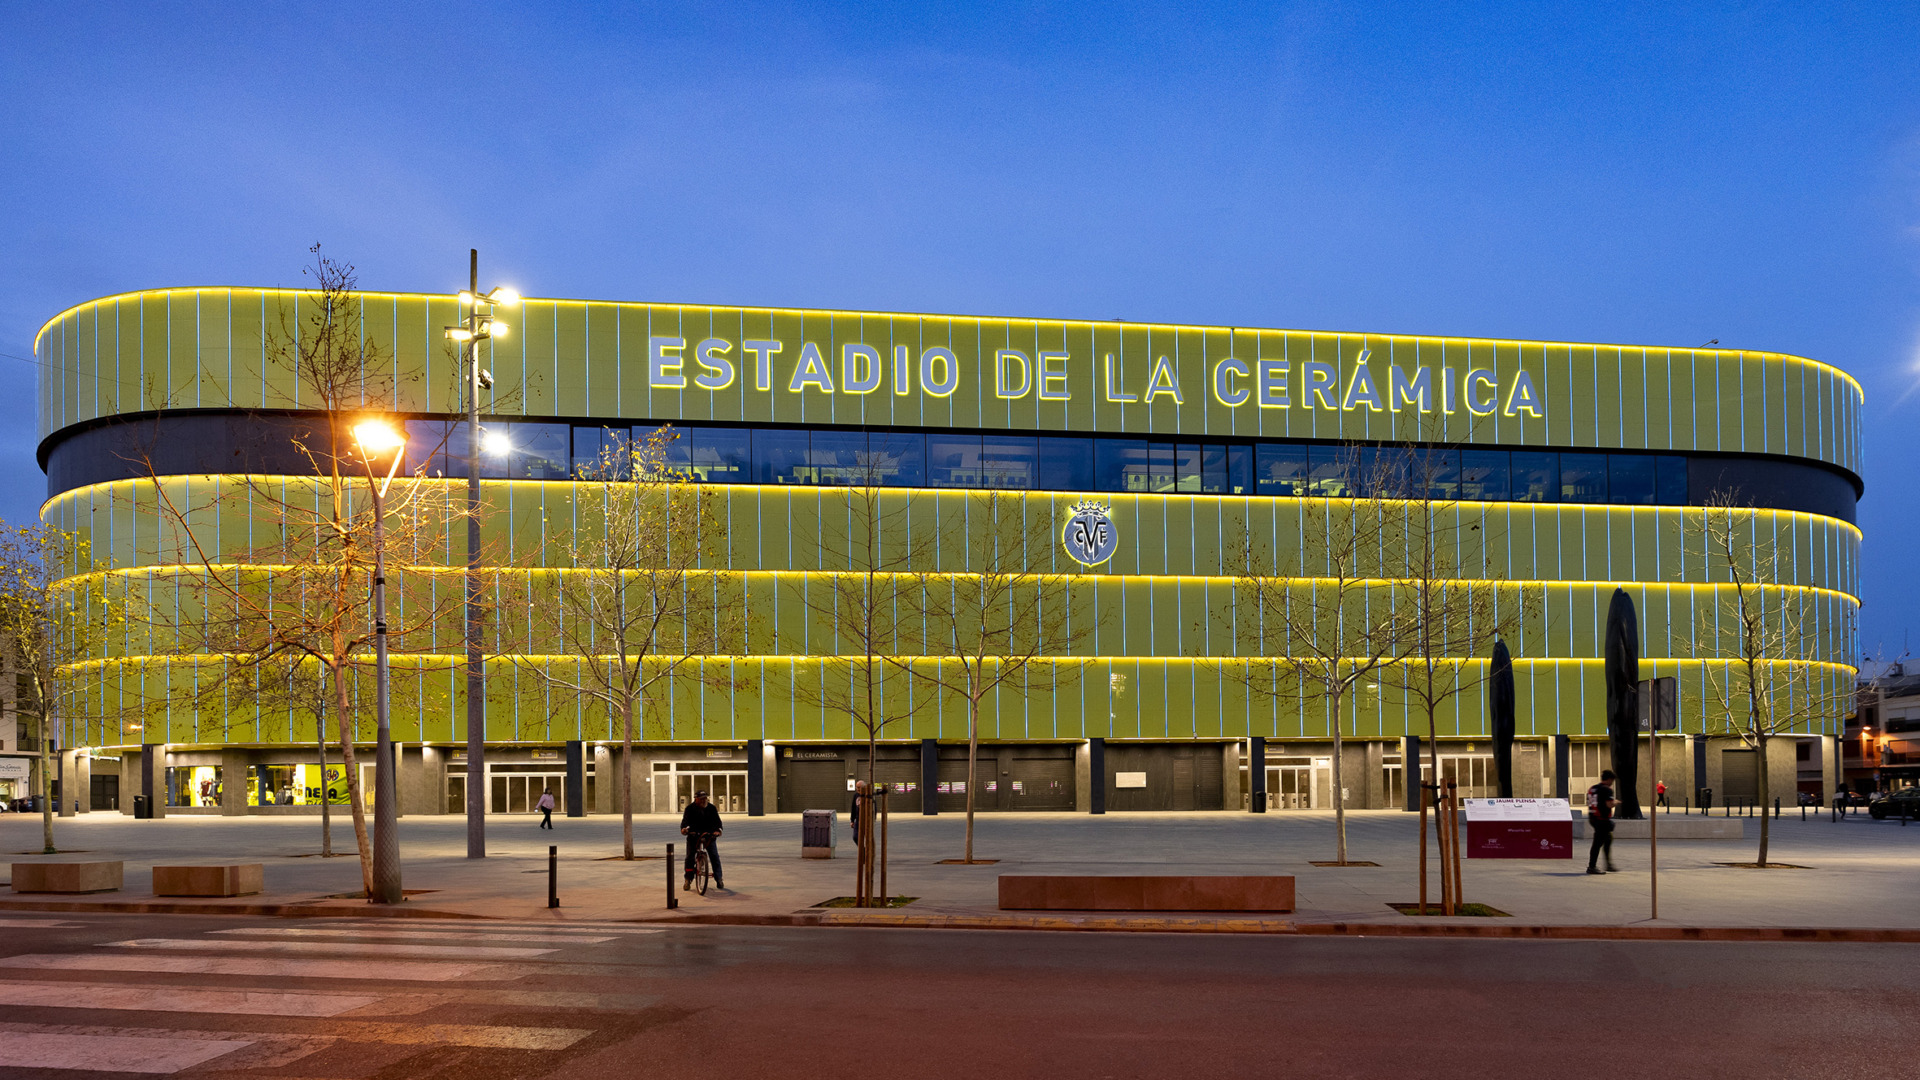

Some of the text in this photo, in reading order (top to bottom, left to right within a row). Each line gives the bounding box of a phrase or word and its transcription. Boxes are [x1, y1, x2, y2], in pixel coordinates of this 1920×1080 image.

[649, 336, 1544, 418] ESTADIO DE LA CERÁMICA
